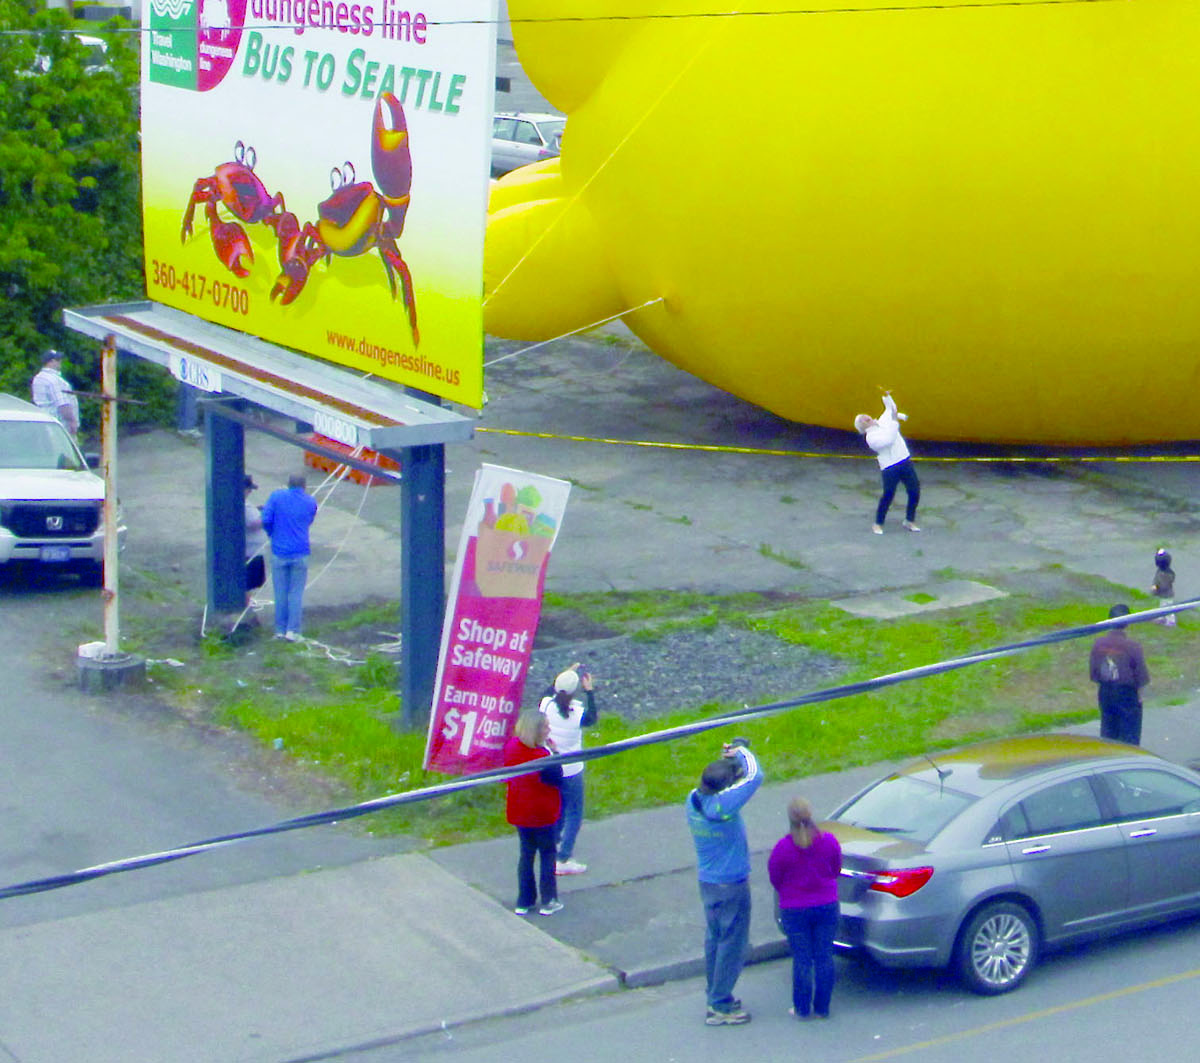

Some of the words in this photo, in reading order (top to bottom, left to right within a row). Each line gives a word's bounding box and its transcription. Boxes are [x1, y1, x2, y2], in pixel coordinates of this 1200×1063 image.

[242, 31, 295, 83] BUS
[303, 50, 336, 91] TO
[152, 260, 249, 315] 360-417-0700
[326, 330, 461, 386] www.dungenessline.us
[457, 618, 507, 651] Shop
[509, 630, 528, 653] at
[451, 644, 522, 682] Safeway
[444, 685, 478, 707] Earn
[481, 694, 497, 714] up
[499, 696, 514, 715] to
